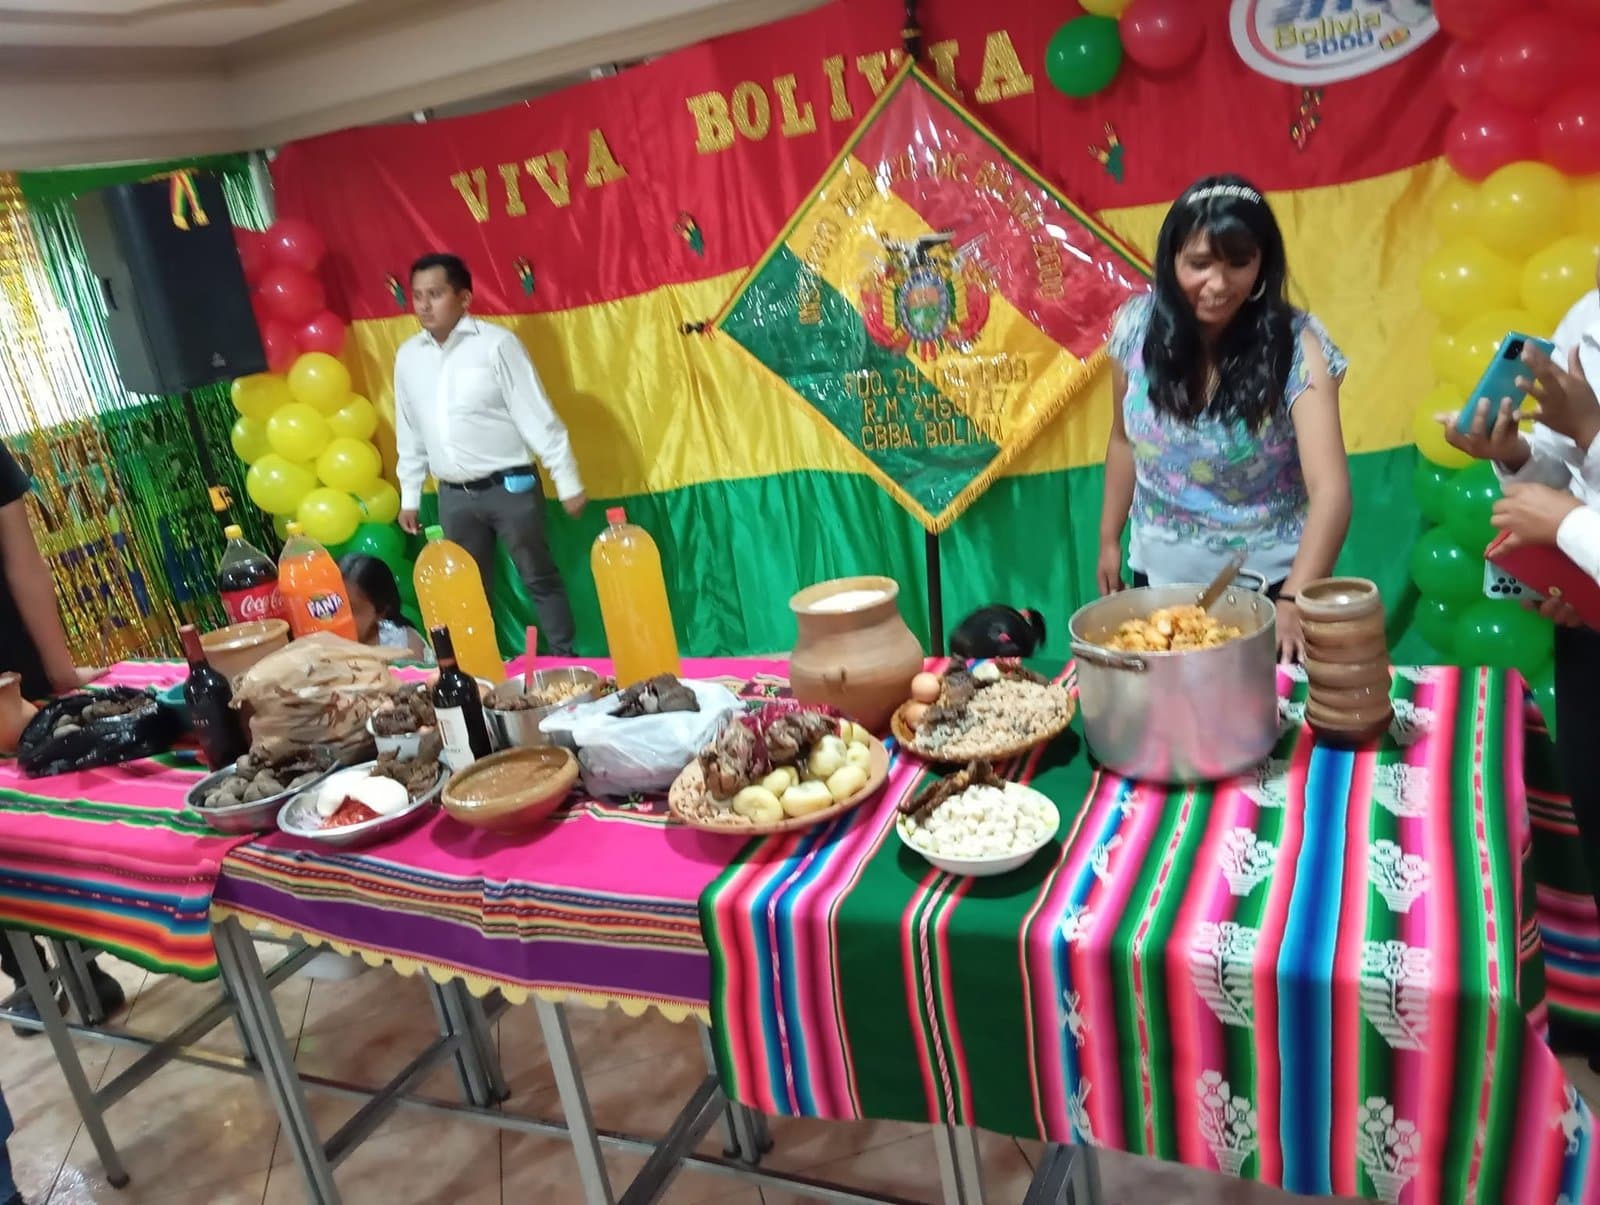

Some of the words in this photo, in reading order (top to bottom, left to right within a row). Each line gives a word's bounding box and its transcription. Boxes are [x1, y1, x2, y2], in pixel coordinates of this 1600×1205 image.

[1274, 8, 1381, 49] Bolivia
[1304, 29, 1374, 59] 2000
[450, 129, 627, 223] VIVA
[924, 414, 1004, 448] BOLIVIA
